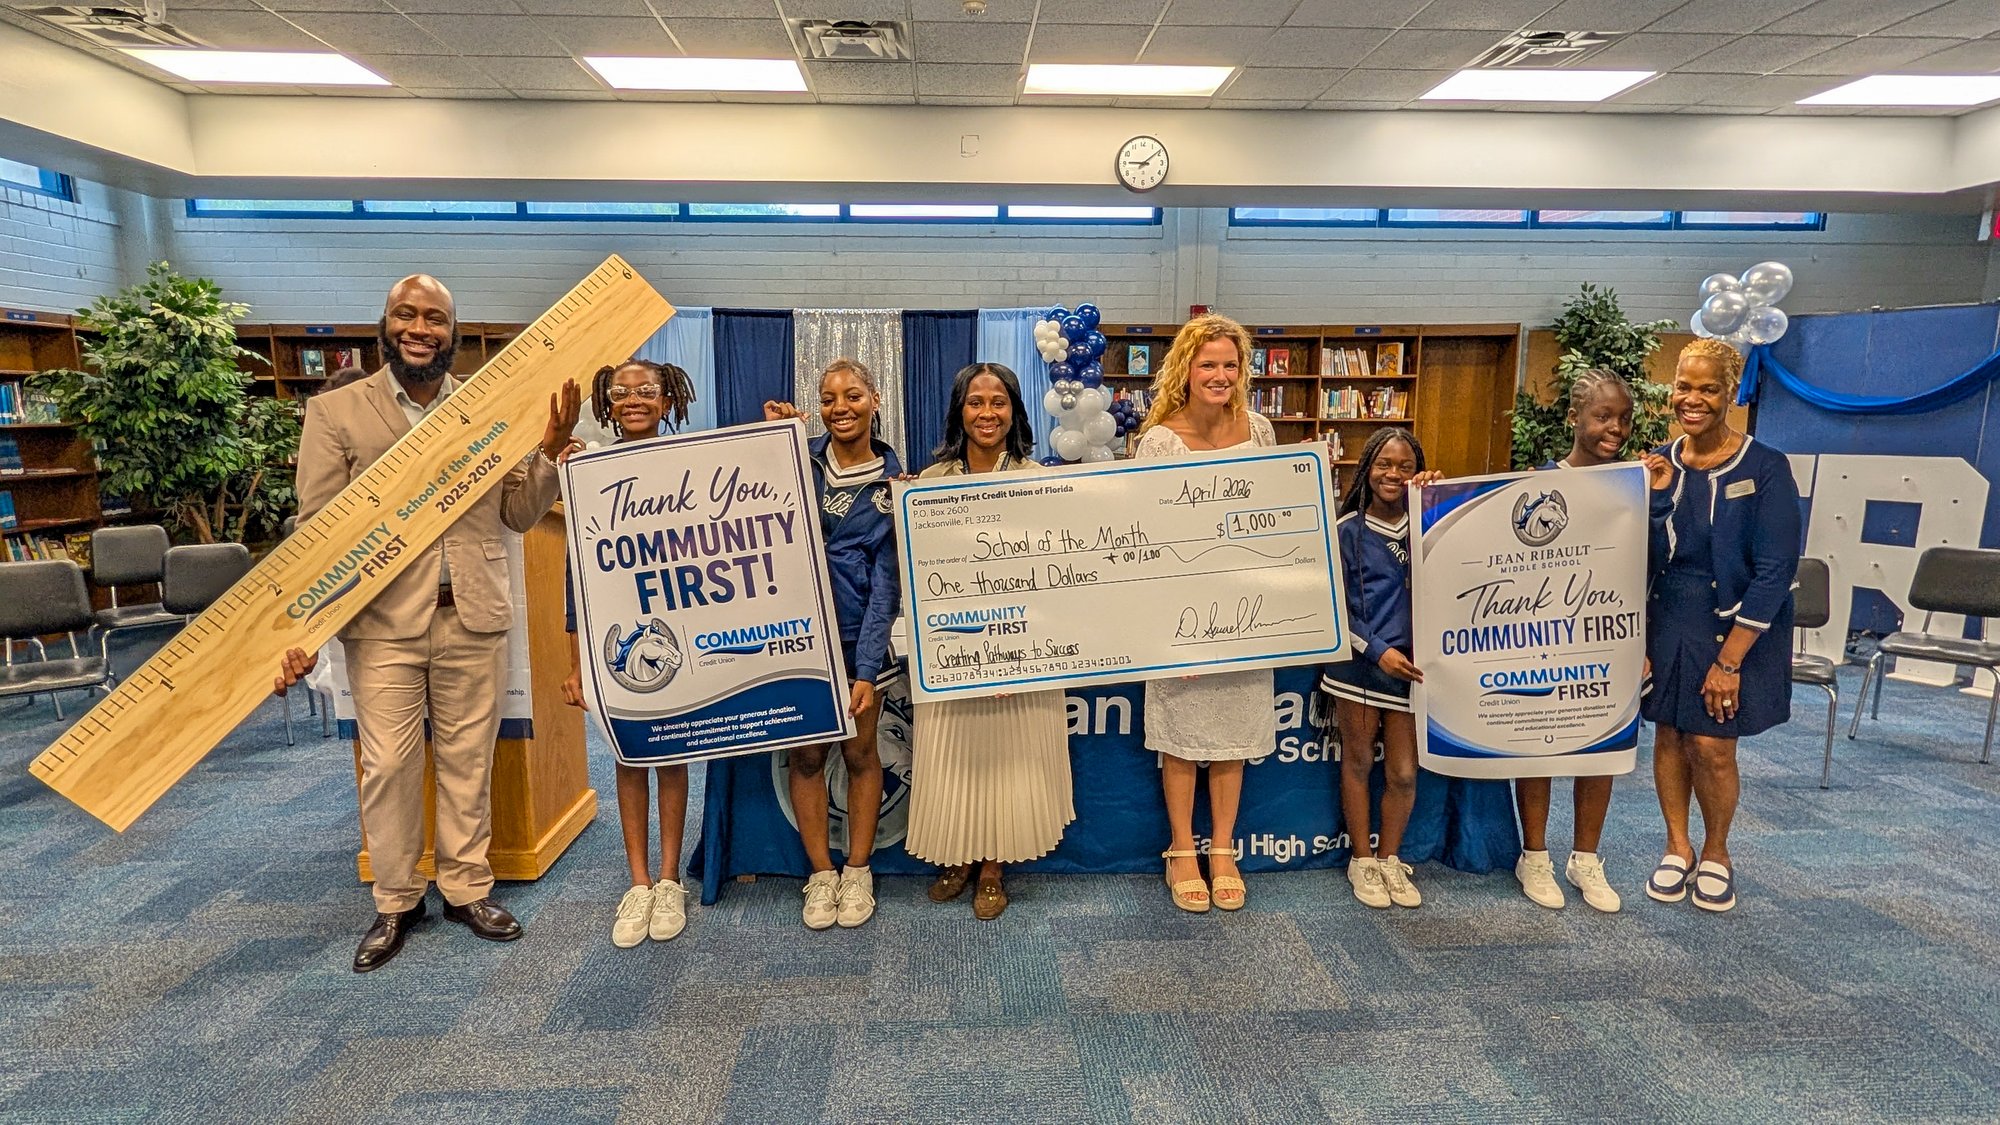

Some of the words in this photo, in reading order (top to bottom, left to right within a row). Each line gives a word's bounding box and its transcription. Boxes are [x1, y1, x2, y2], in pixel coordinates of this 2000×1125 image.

[622, 269, 633, 280] 6
[542, 338, 555, 351] 5
[459, 414, 471, 426] 4
[396, 481, 438, 521] School
[437, 469, 453, 489] of
[448, 453, 472, 476] the
[467, 419, 509, 457] Month
[1292, 463, 1311, 473] 101
[435, 453, 502, 514] 2025-2026
[1175, 476, 1216, 508] April
[1223, 478, 1254, 497] 2026
[367, 495, 381, 508] 3
[600, 469, 697, 531] Thank
[709, 466, 778, 521] You,
[912, 496, 959, 506] Community
[961, 493, 980, 502] First
[982, 490, 1007, 499] Credit
[1009, 489, 1033, 497] Union
[1035, 487, 1043, 495] of
[1045, 485, 1073, 494] Florida
[913, 510, 928, 518] P.O.
[947, 506, 969, 515] 2600
[914, 519, 963, 530] Jacksonville,
[976, 514, 1001, 524] 32232
[596, 510, 795, 572] COMMUNITY
[973, 531, 1029, 560] School
[1038, 529, 1052, 552] of
[1058, 529, 1088, 554] the
[1091, 521, 1150, 551] Month
[1216, 523, 1225, 538] $
[361, 534, 408, 578] FIRST
[961, 555, 968, 563] of
[1295, 557, 1316, 565] Dollars
[1487, 552, 1525, 568] JEAN
[1530, 545, 1590, 561] RIBAULT
[1500, 564, 1536, 573] MIDDLE
[1542, 559, 1581, 569] SCHOOL
[286, 522, 392, 619] COMMUNITY
[928, 572, 964, 596] One
[970, 567, 1038, 595] thousand
[1048, 563, 1098, 587] Dollars
[268, 583, 283, 597] 2
[634, 552, 778, 615] FIRST!
[1456, 577, 1554, 625] Thank
[1564, 569, 1623, 618] You,
[308, 618, 326, 635] Credit
[326, 603, 343, 619] Union
[927, 606, 1026, 628] COMMUNITY
[694, 617, 812, 650] COMMUNITY
[988, 621, 1028, 636] FIRST
[1442, 618, 1576, 656] COMMUNITY
[1584, 612, 1640, 642] FIRST!
[768, 635, 815, 656] FIRST
[1030, 640, 1041, 659] to
[1045, 638, 1079, 656] Success
[699, 659, 717, 667] Credit
[718, 656, 736, 665] Union
[160, 679, 176, 692] 1
[1480, 663, 1610, 688] COMMUNITY
[1558, 682, 1610, 700] FIRST
[661, 731, 691, 740] continued
[692, 725, 731, 736] commitment
[740, 720, 763, 729] support
[764, 714, 803, 726] achievement
[663, 721, 690, 730] sincerely
[691, 716, 723, 727] appreciate
[725, 715, 738, 723] your
[740, 710, 768, 721] generous
[768, 706, 796, 715] donation
[700, 734, 735, 744] educational
[736, 730, 768, 739] excellence.
[1251, 834, 1305, 863] High
